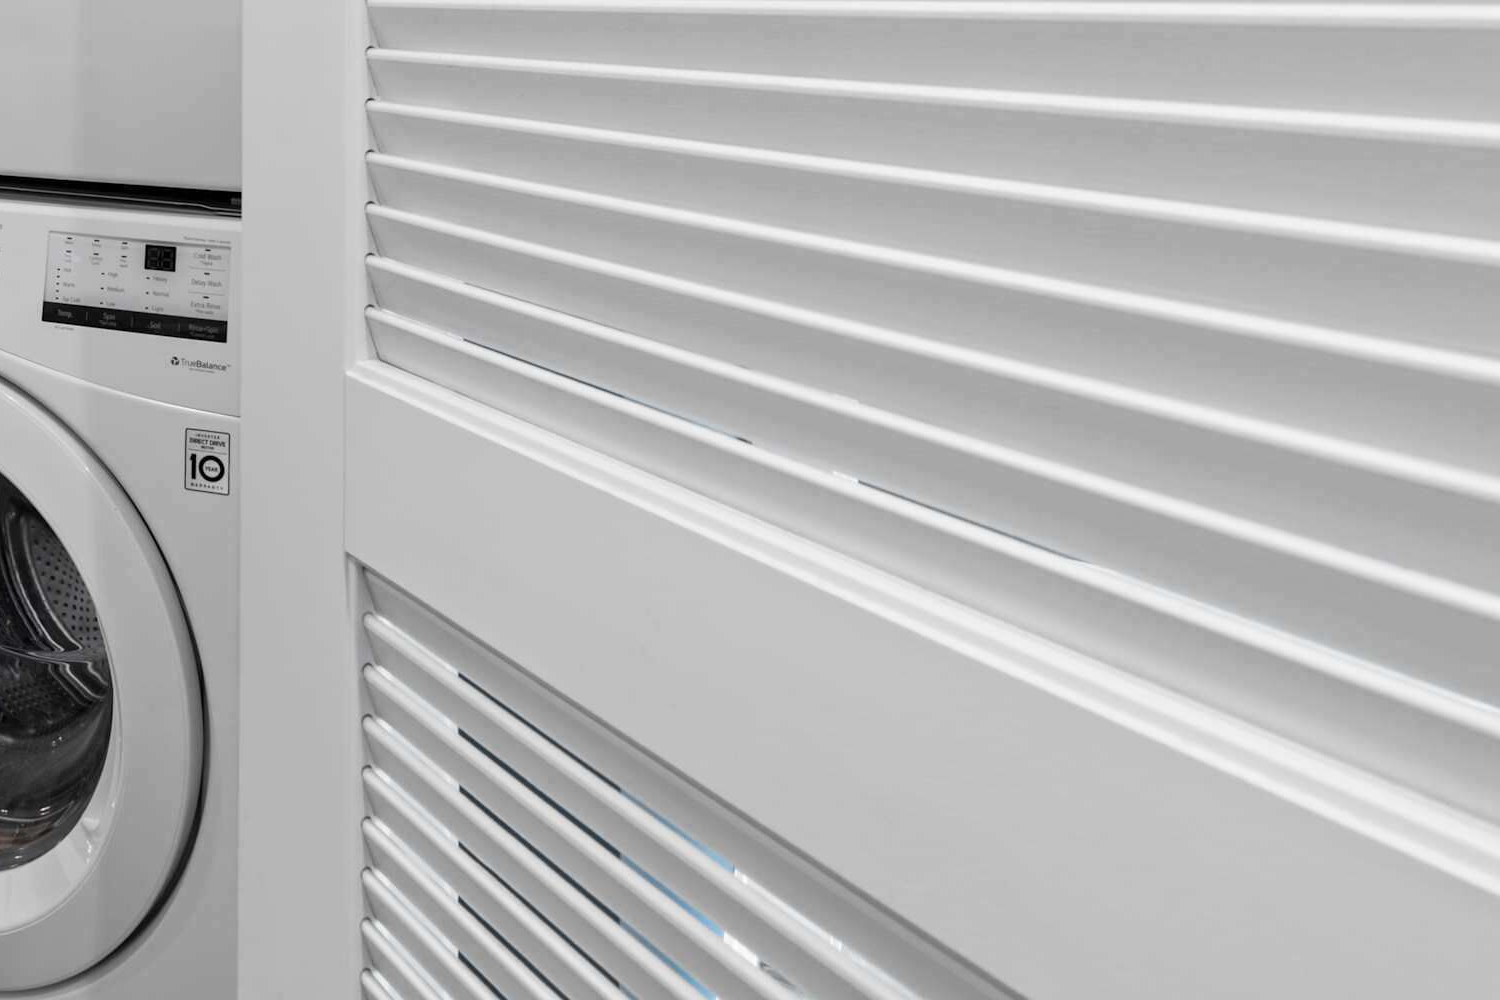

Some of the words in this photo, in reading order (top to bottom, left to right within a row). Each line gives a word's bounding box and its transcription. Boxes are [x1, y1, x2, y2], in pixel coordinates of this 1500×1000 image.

[189, 437, 209, 446] DIRECT
[209, 440, 226, 448] DRIVE
[189, 453, 225, 483] 10
